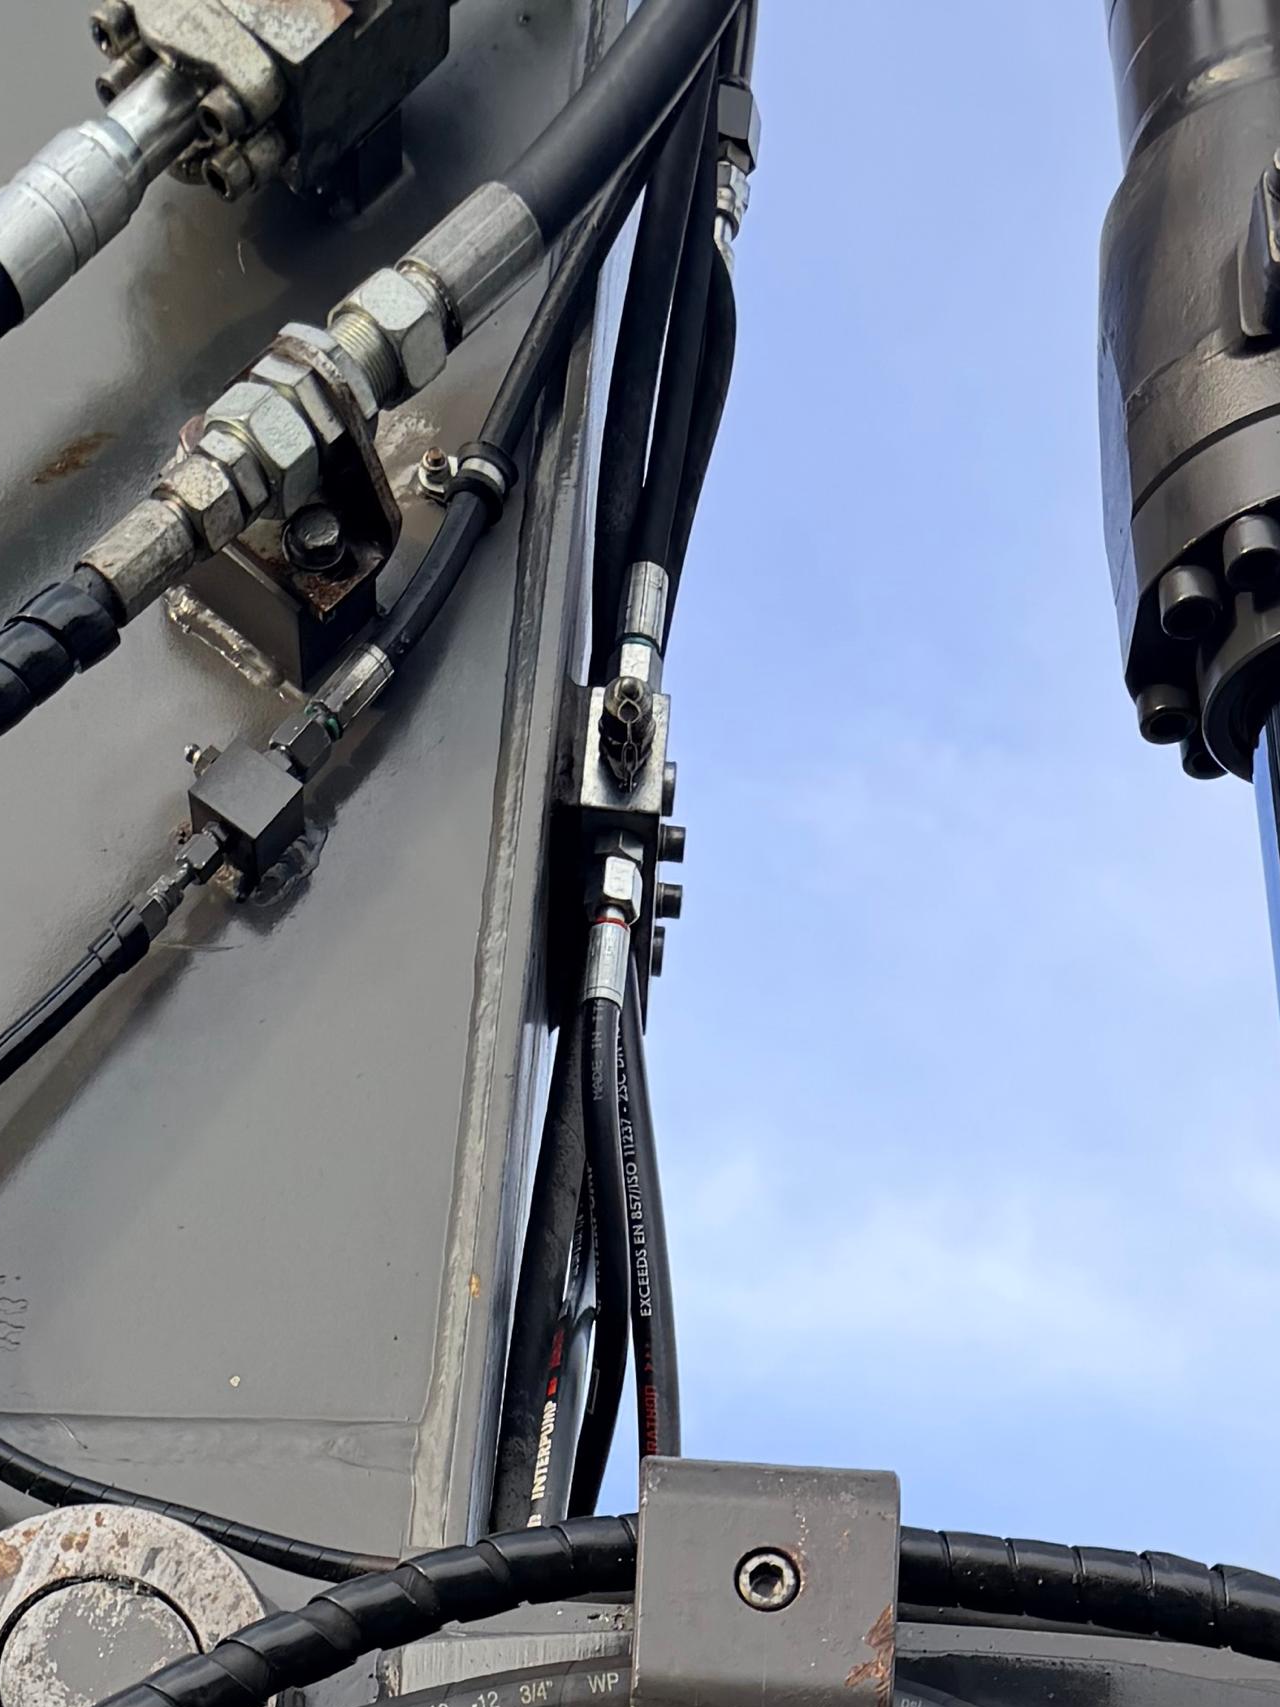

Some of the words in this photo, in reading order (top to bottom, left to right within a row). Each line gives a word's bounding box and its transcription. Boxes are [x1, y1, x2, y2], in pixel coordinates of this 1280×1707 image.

[621, 1117, 636, 1157] 11237
[633, 1222, 647, 1247] EN
[636, 1247, 653, 1318] EXCEEDS
[531, 1400, 558, 1501] INTERPUMP
[588, 1671, 620, 1695] WP
